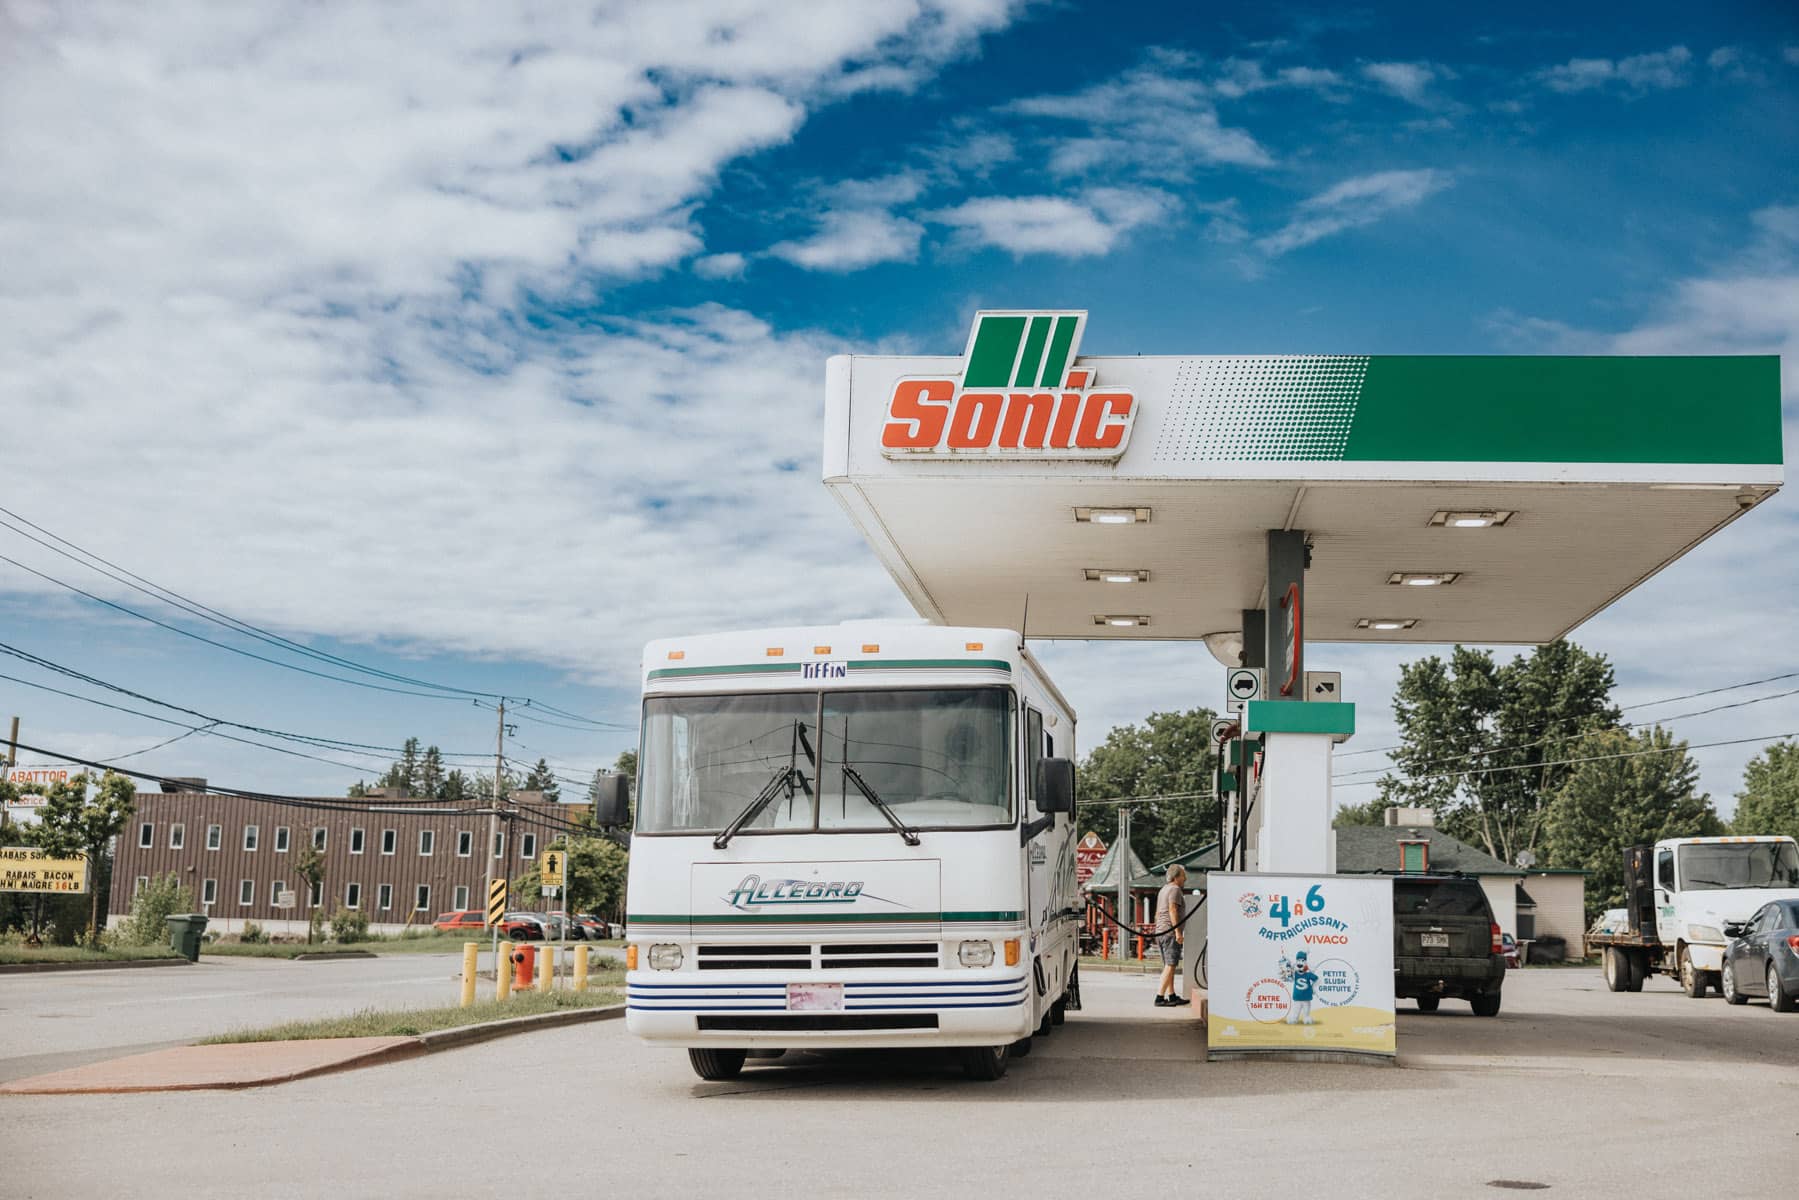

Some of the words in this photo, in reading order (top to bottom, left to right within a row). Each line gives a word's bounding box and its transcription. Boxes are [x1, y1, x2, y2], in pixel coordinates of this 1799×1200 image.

[10, 769, 68, 783] ABATTOIR
[6, 870, 36, 880] RABAIS
[43, 871, 74, 880] BACON
[20, 880, 52, 890] MAIGRE
[1269, 894, 1279, 902] LE
[1269, 895, 1291, 927] 4
[1305, 884, 1325, 912] 6
[1258, 916, 1348, 941] RAFRAICHISSANT
[1304, 935, 1348, 945] VIVACO
[1318, 985, 1351, 993] GRATUITE
